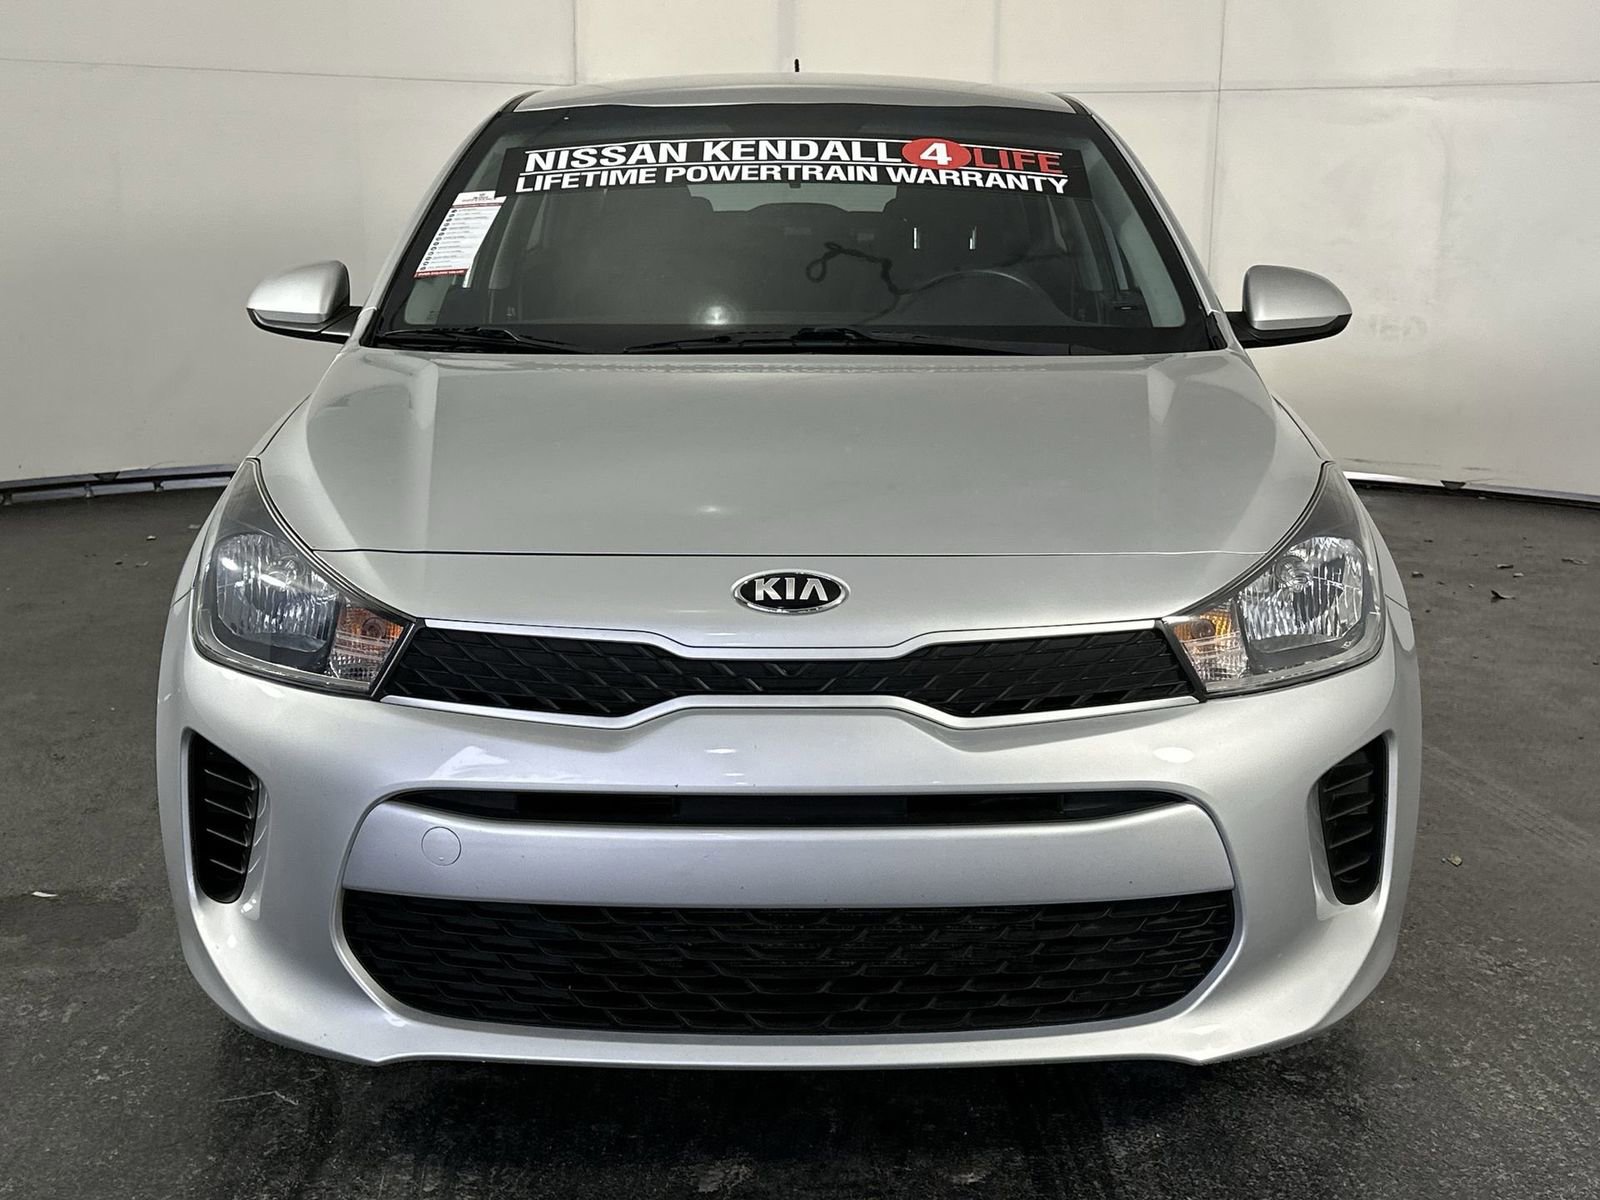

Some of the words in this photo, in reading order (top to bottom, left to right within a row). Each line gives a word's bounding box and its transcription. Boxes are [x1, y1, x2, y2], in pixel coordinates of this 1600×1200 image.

[524, 142, 688, 172] NISSAN
[702, 140, 902, 163] KENDALL
[919, 142, 953, 166] 4
[974, 147, 1064, 174] LIFE
[515, 167, 658, 193] LIFETIME
[665, 164, 879, 184] POWERTRAIN
[886, 166, 1069, 195] WARRANTY
[754, 577, 829, 602] KIA
